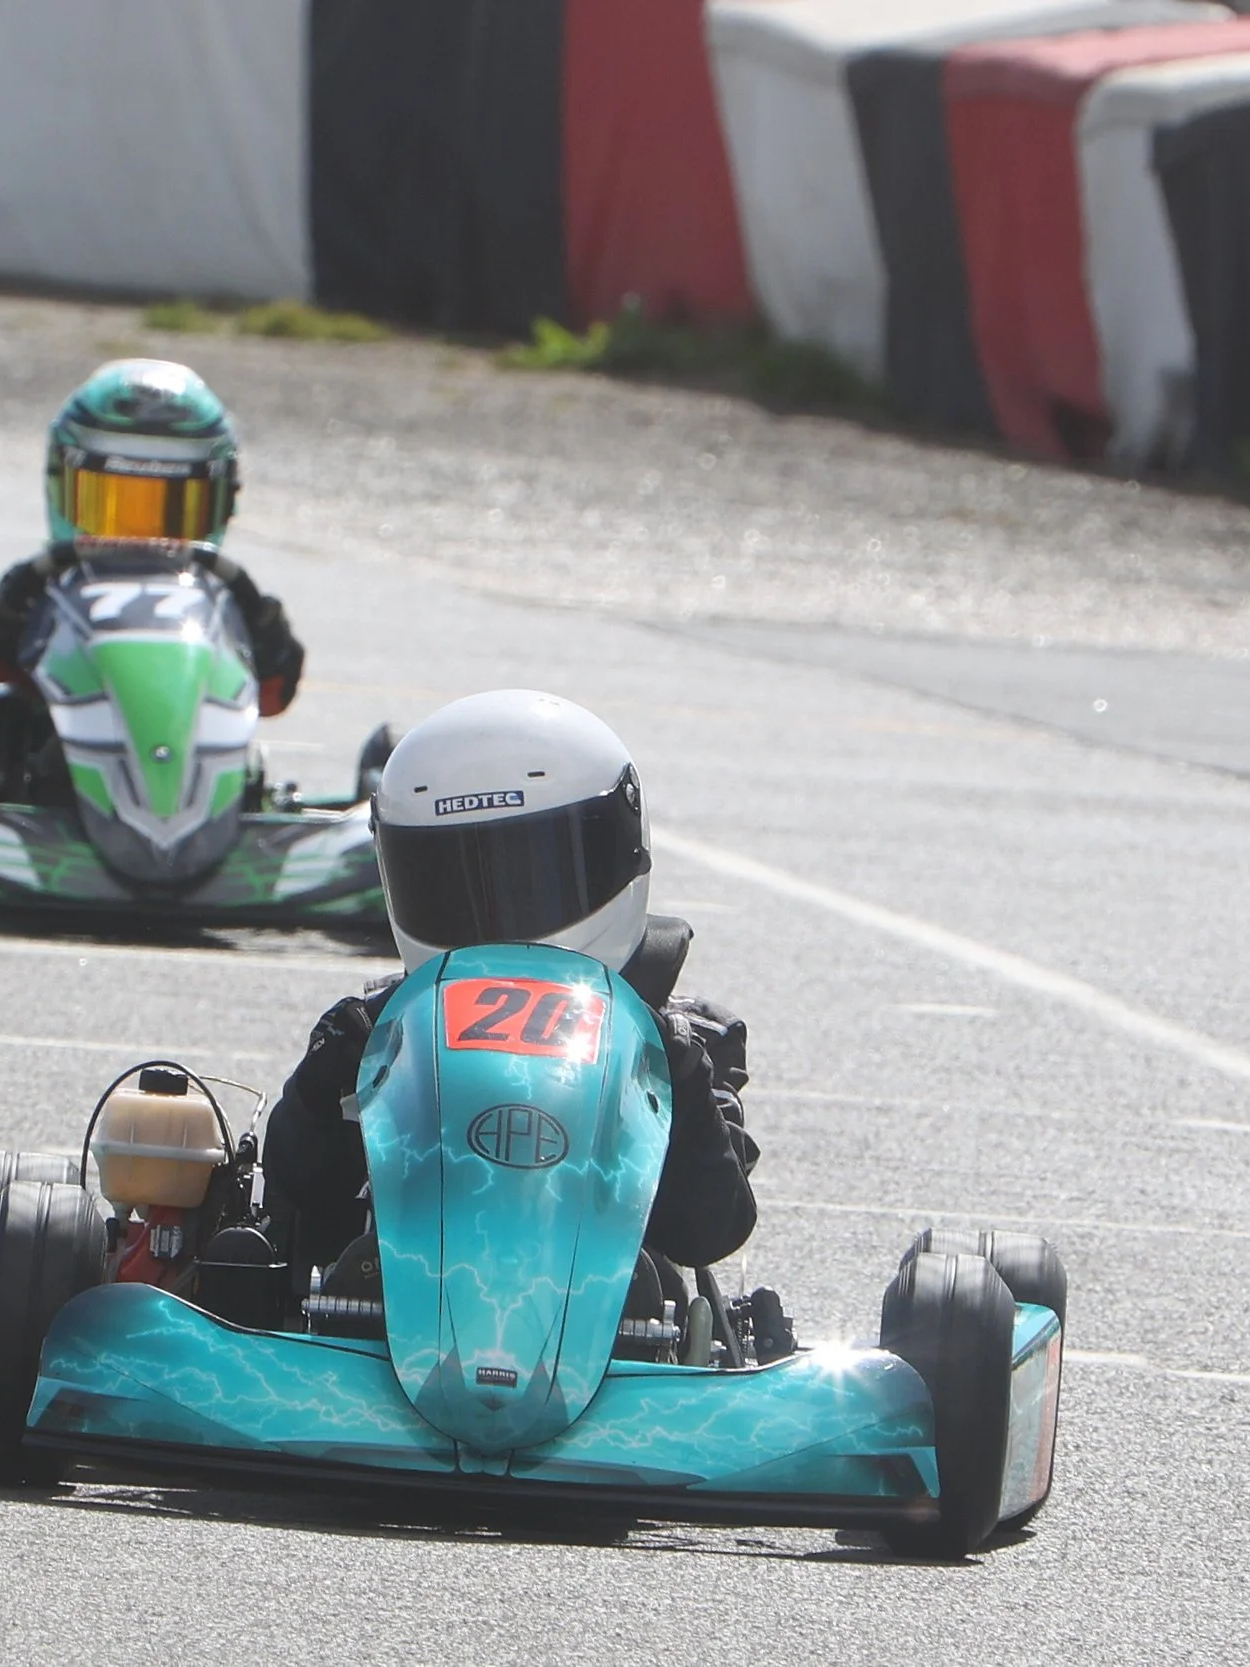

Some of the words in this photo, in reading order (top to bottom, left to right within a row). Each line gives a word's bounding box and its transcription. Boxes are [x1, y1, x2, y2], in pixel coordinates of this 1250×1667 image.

[80, 582, 206, 622] 77
[438, 792, 522, 814] HEDTEC
[458, 986, 584, 1047] 20
